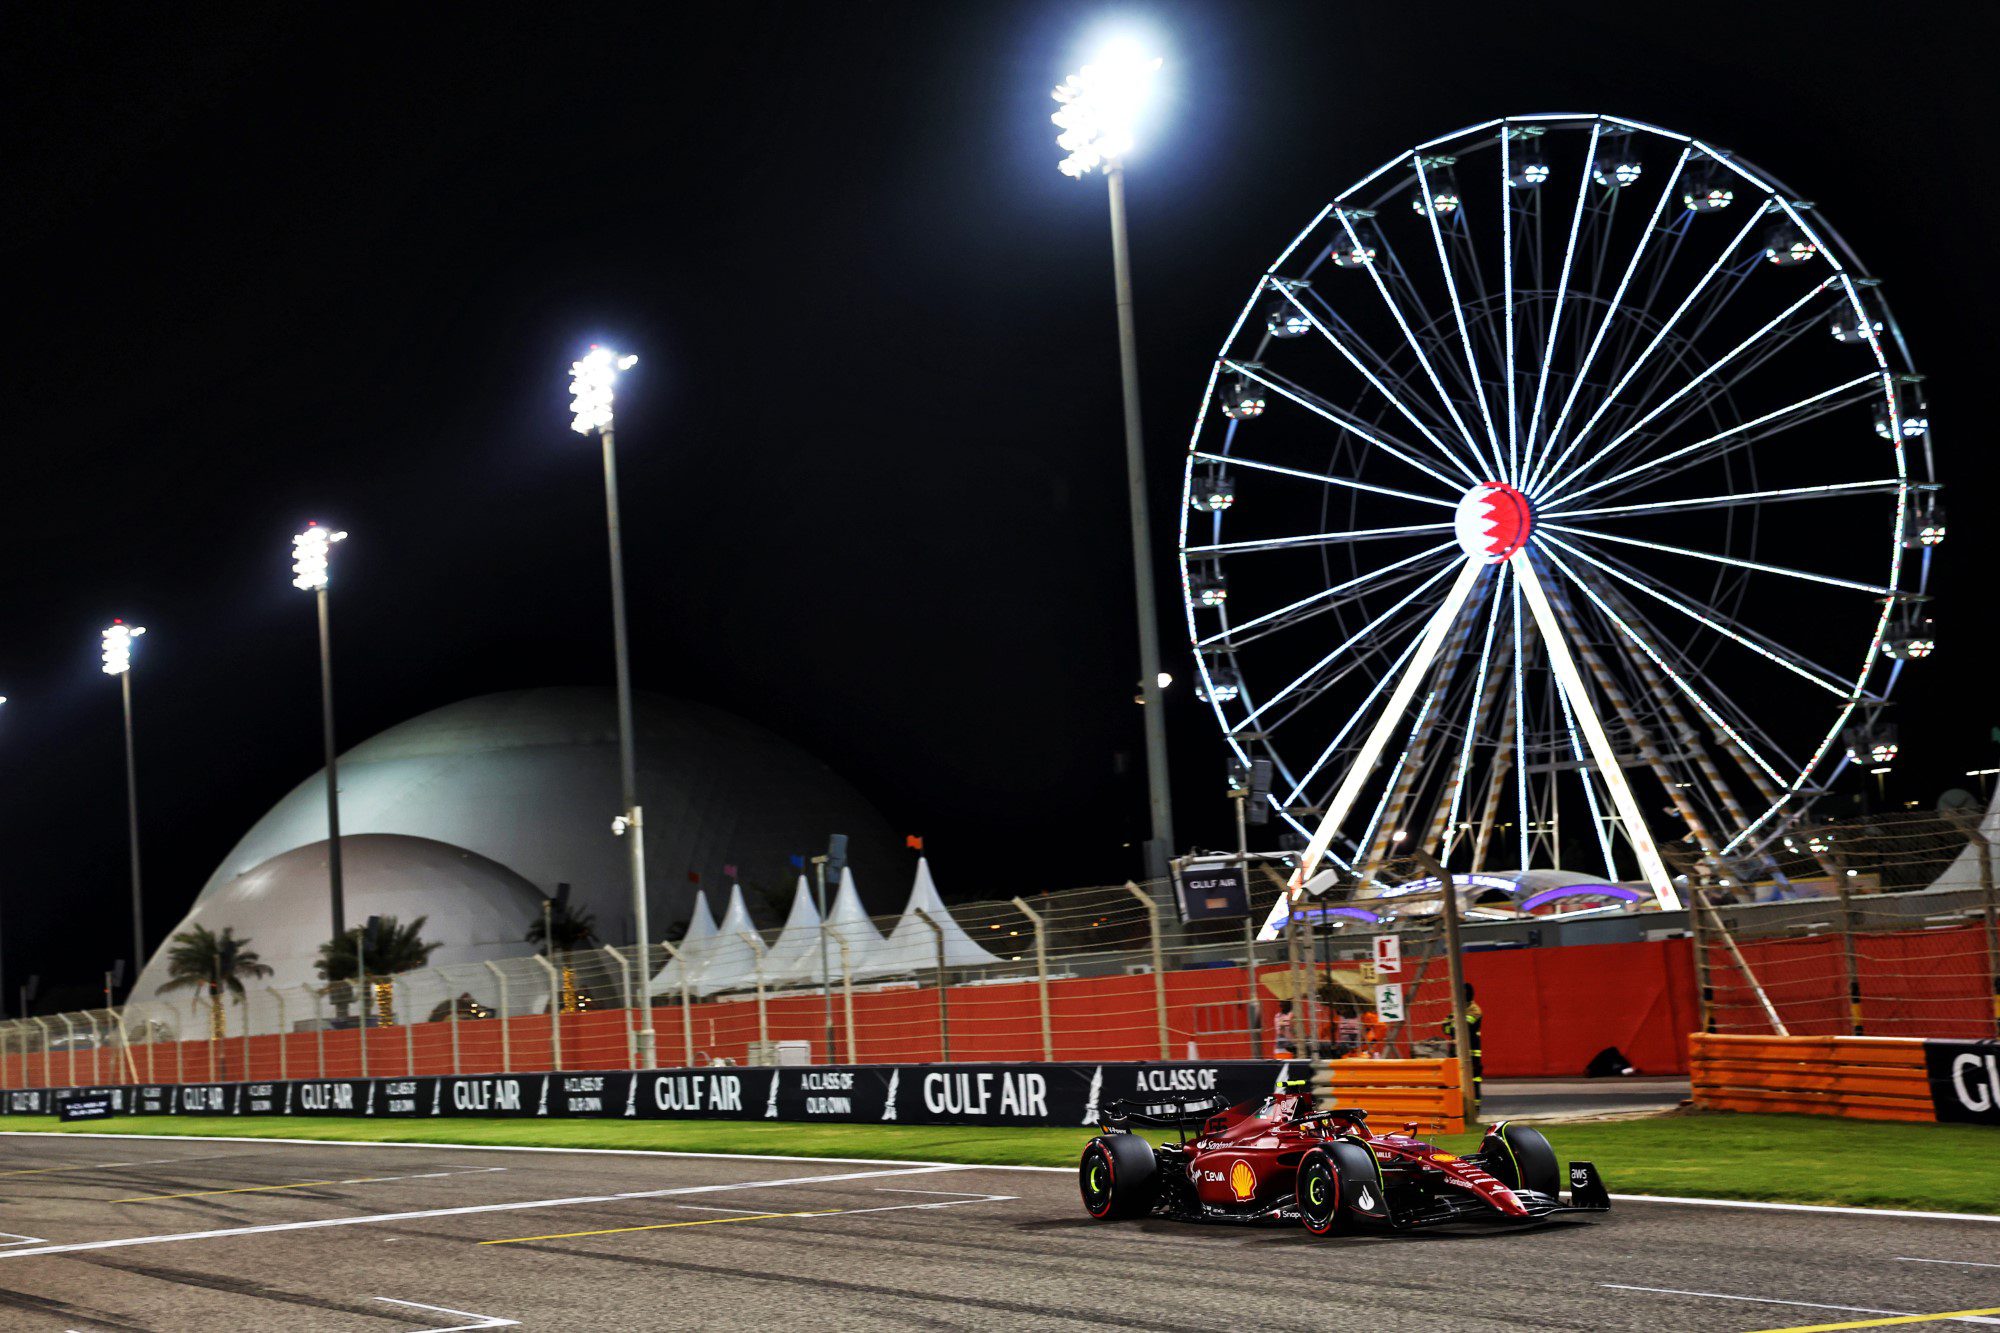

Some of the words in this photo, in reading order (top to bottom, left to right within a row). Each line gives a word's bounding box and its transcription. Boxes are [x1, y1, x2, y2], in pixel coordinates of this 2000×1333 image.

[654, 1076, 704, 1111] GULF
[708, 1075, 742, 1112] AIR
[1136, 1071, 1148, 1092] A
[1149, 1069, 1196, 1091] CLASS
[1198, 1069, 1218, 1090] OF
[453, 1080, 492, 1110] GULF
[494, 1080, 521, 1110] AIR
[924, 1073, 993, 1115] GULF
[1000, 1072, 1048, 1116] AIR
[1449, 1177, 1474, 1189] Santander
[1571, 1169, 1587, 1179] aws
